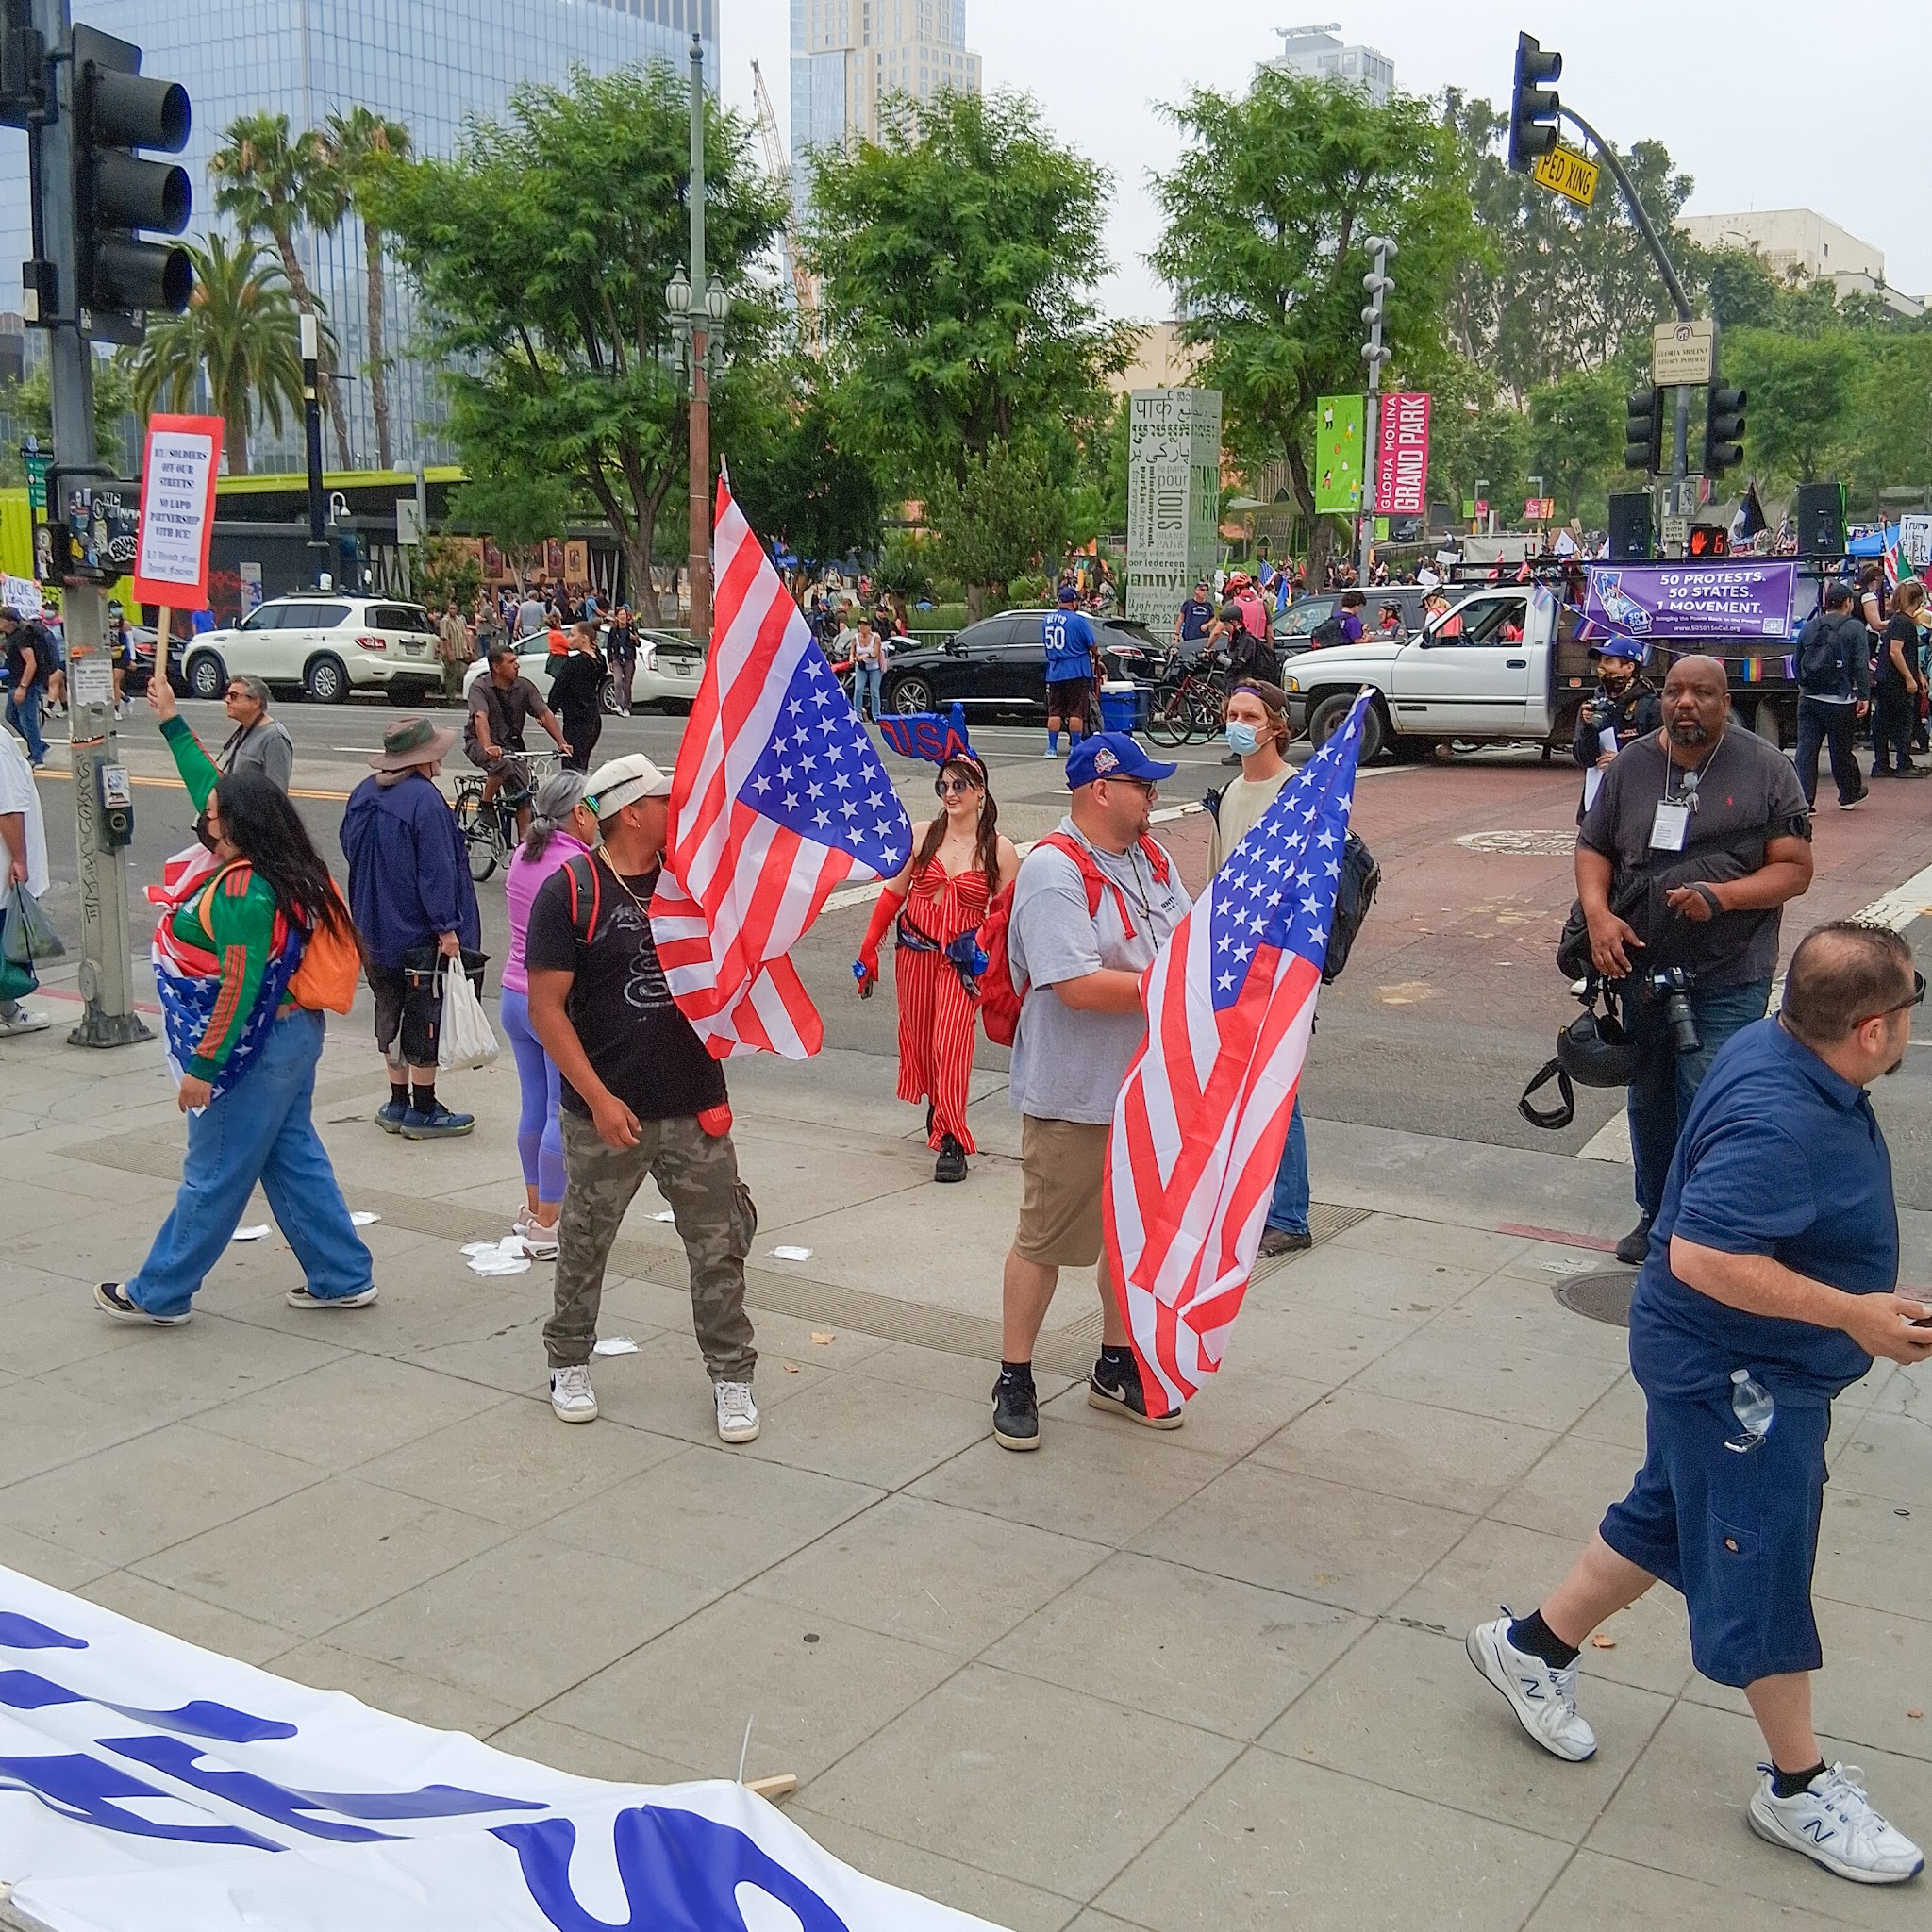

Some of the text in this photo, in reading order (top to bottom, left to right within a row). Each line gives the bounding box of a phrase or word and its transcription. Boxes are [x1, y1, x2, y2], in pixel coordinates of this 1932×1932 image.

[1541, 154, 1591, 196] PED XING
[1380, 396, 1396, 509] GLORIA MOLINA
[1393, 396, 1425, 510] GRAND PARK
[1158, 475, 1188, 489] pour
[1158, 489, 1187, 530] tous
[1905, 516, 1929, 534] Trump
[1157, 540, 1184, 549] PARK
[1713, 533, 1724, 554] 6
[1659, 572, 1767, 585] 50 PROTESTS.
[1668, 586, 1754, 598] 50 STATES.
[1640, 611, 1649, 625] 1
[1657, 600, 1763, 614] 1 MOVEMENT.
[1044, 625, 1066, 651] 50
[878, 719, 967, 759] USA
[1520, 1677, 1546, 1701] N
[1801, 1818, 1836, 1845] N
